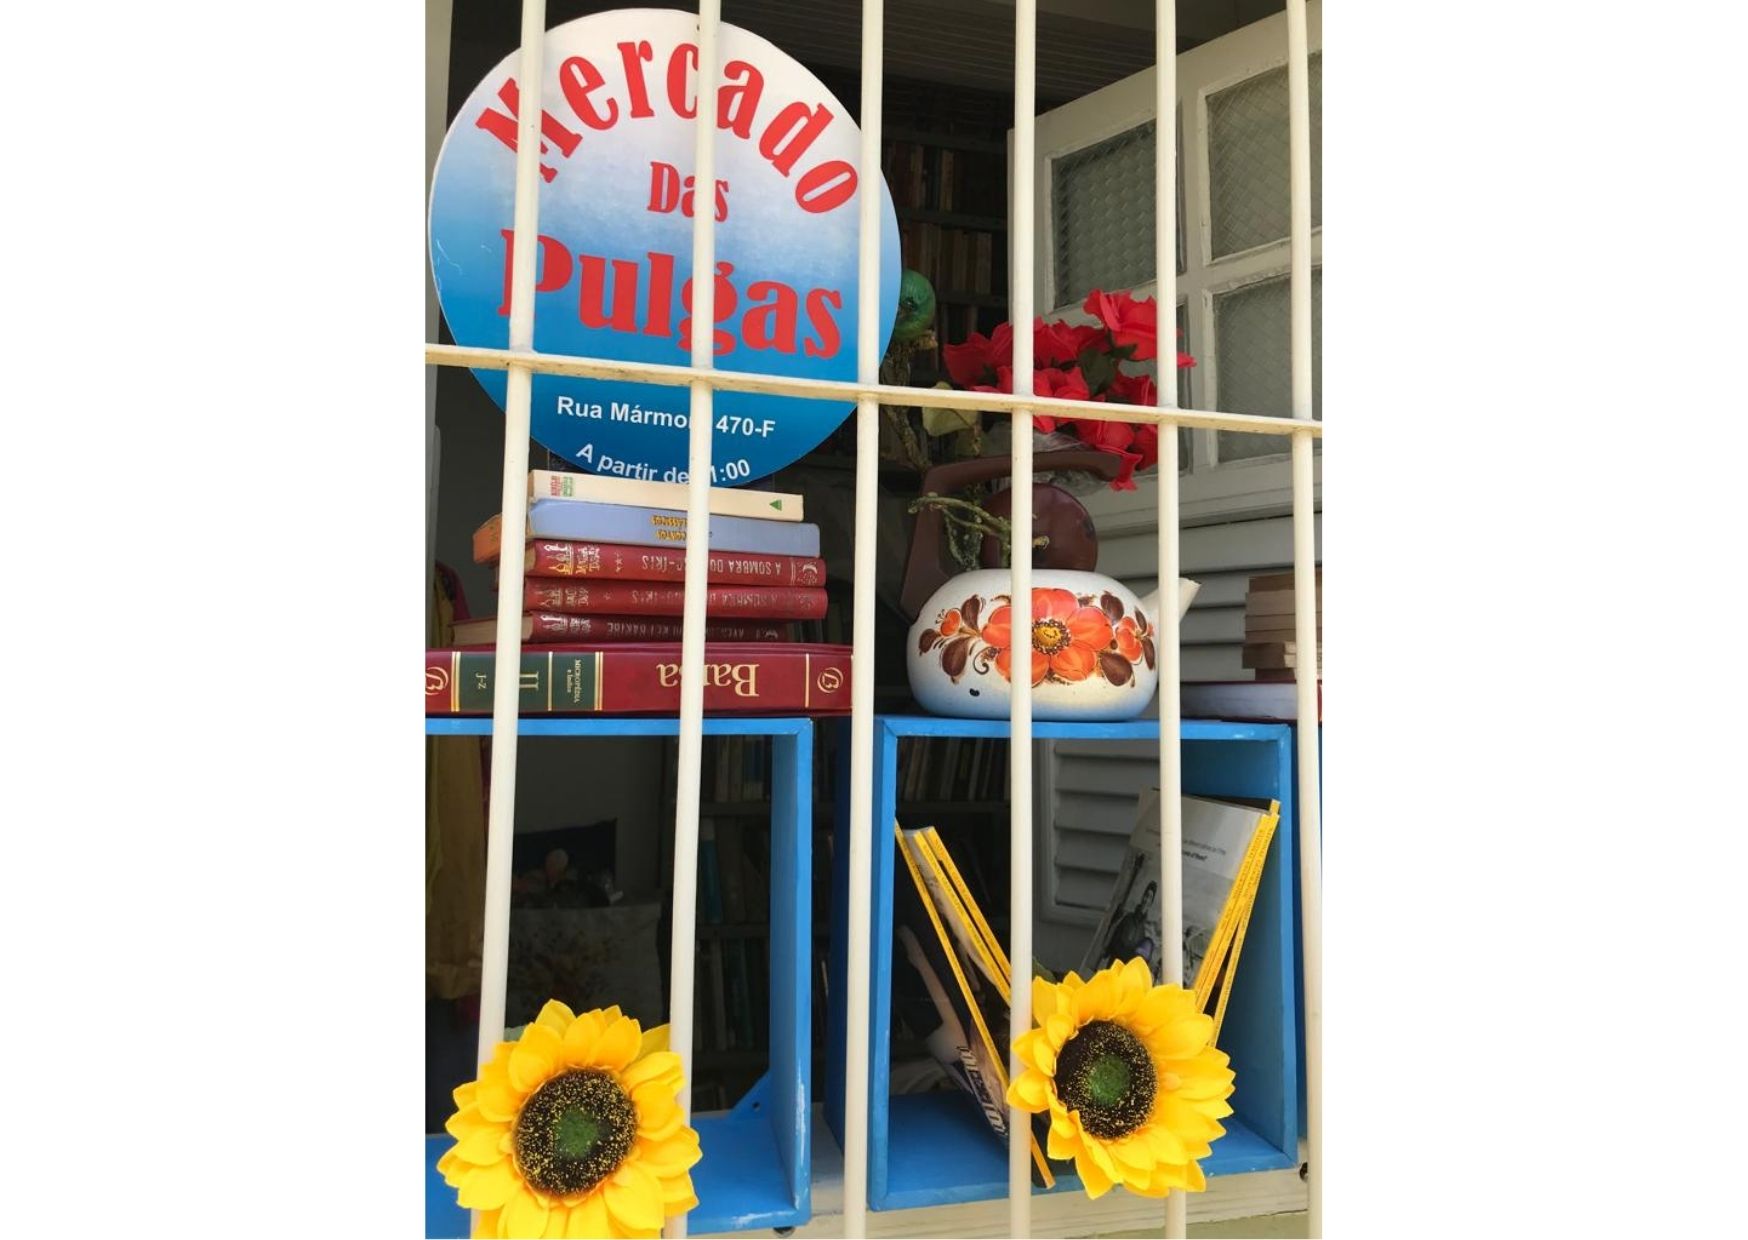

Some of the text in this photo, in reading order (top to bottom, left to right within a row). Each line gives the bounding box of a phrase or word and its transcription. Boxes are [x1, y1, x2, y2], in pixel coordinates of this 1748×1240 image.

[475, 39, 859, 215] Mercado
[497, 229, 842, 359] Pulgas
[557, 396, 775, 438] Rua Mármo 470-F
[576, 443, 750, 484] A partir de 1:00
[728, 558, 771, 575] SOMBRA
[775, 560, 782, 575] A
[476, 672, 487, 690] J-Z
[656, 663, 760, 697] Bara
